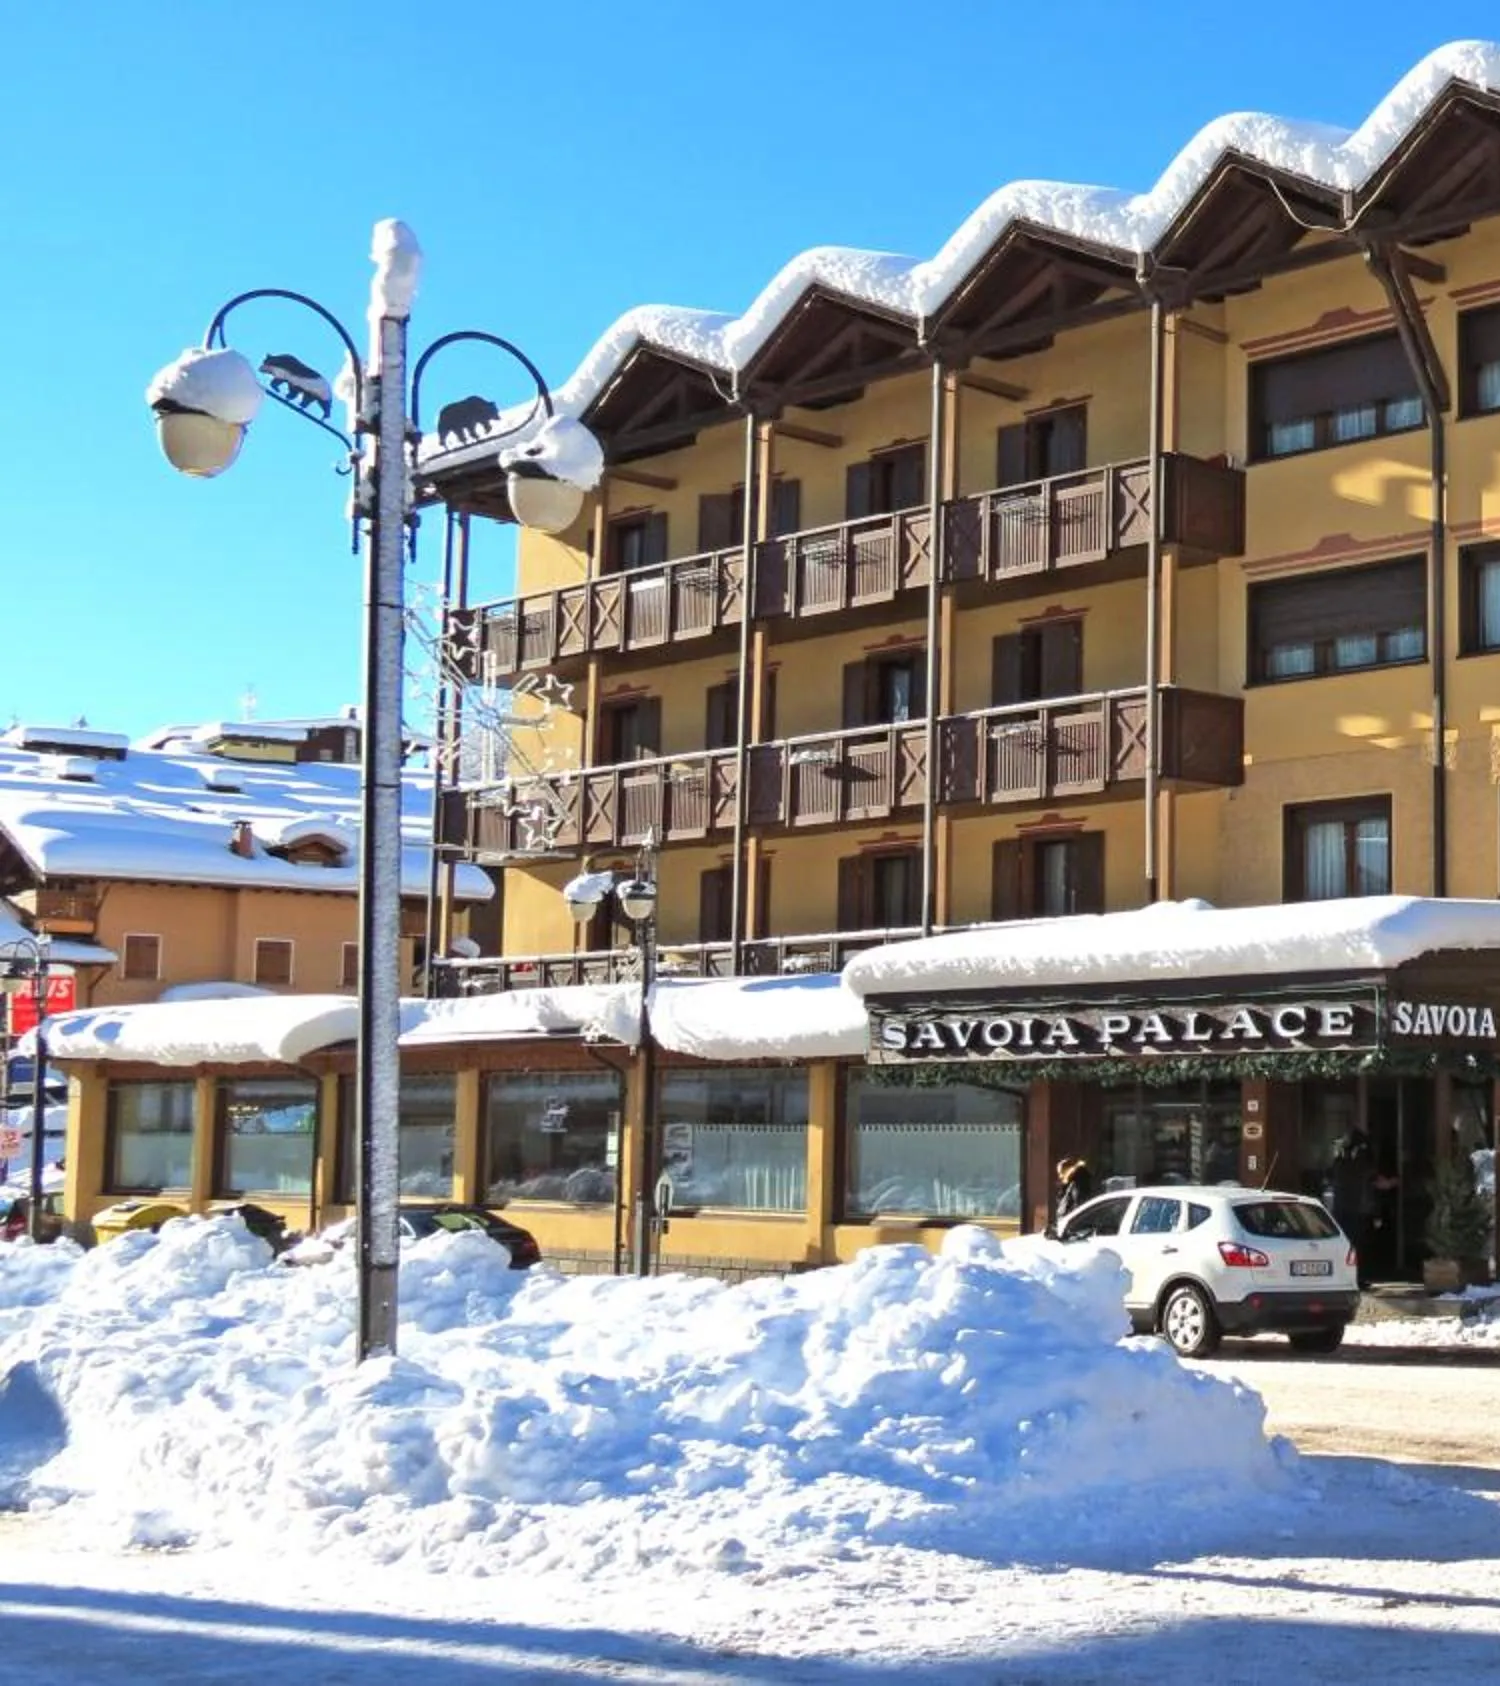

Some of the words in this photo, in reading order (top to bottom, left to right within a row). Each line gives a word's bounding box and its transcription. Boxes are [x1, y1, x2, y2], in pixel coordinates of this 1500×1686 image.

[14, 979, 72, 999] AIS
[881, 1017, 1079, 1050] SAVOIA
[1097, 1006, 1355, 1043] PALACE
[1395, 1001, 1498, 1038] SAVOIA
